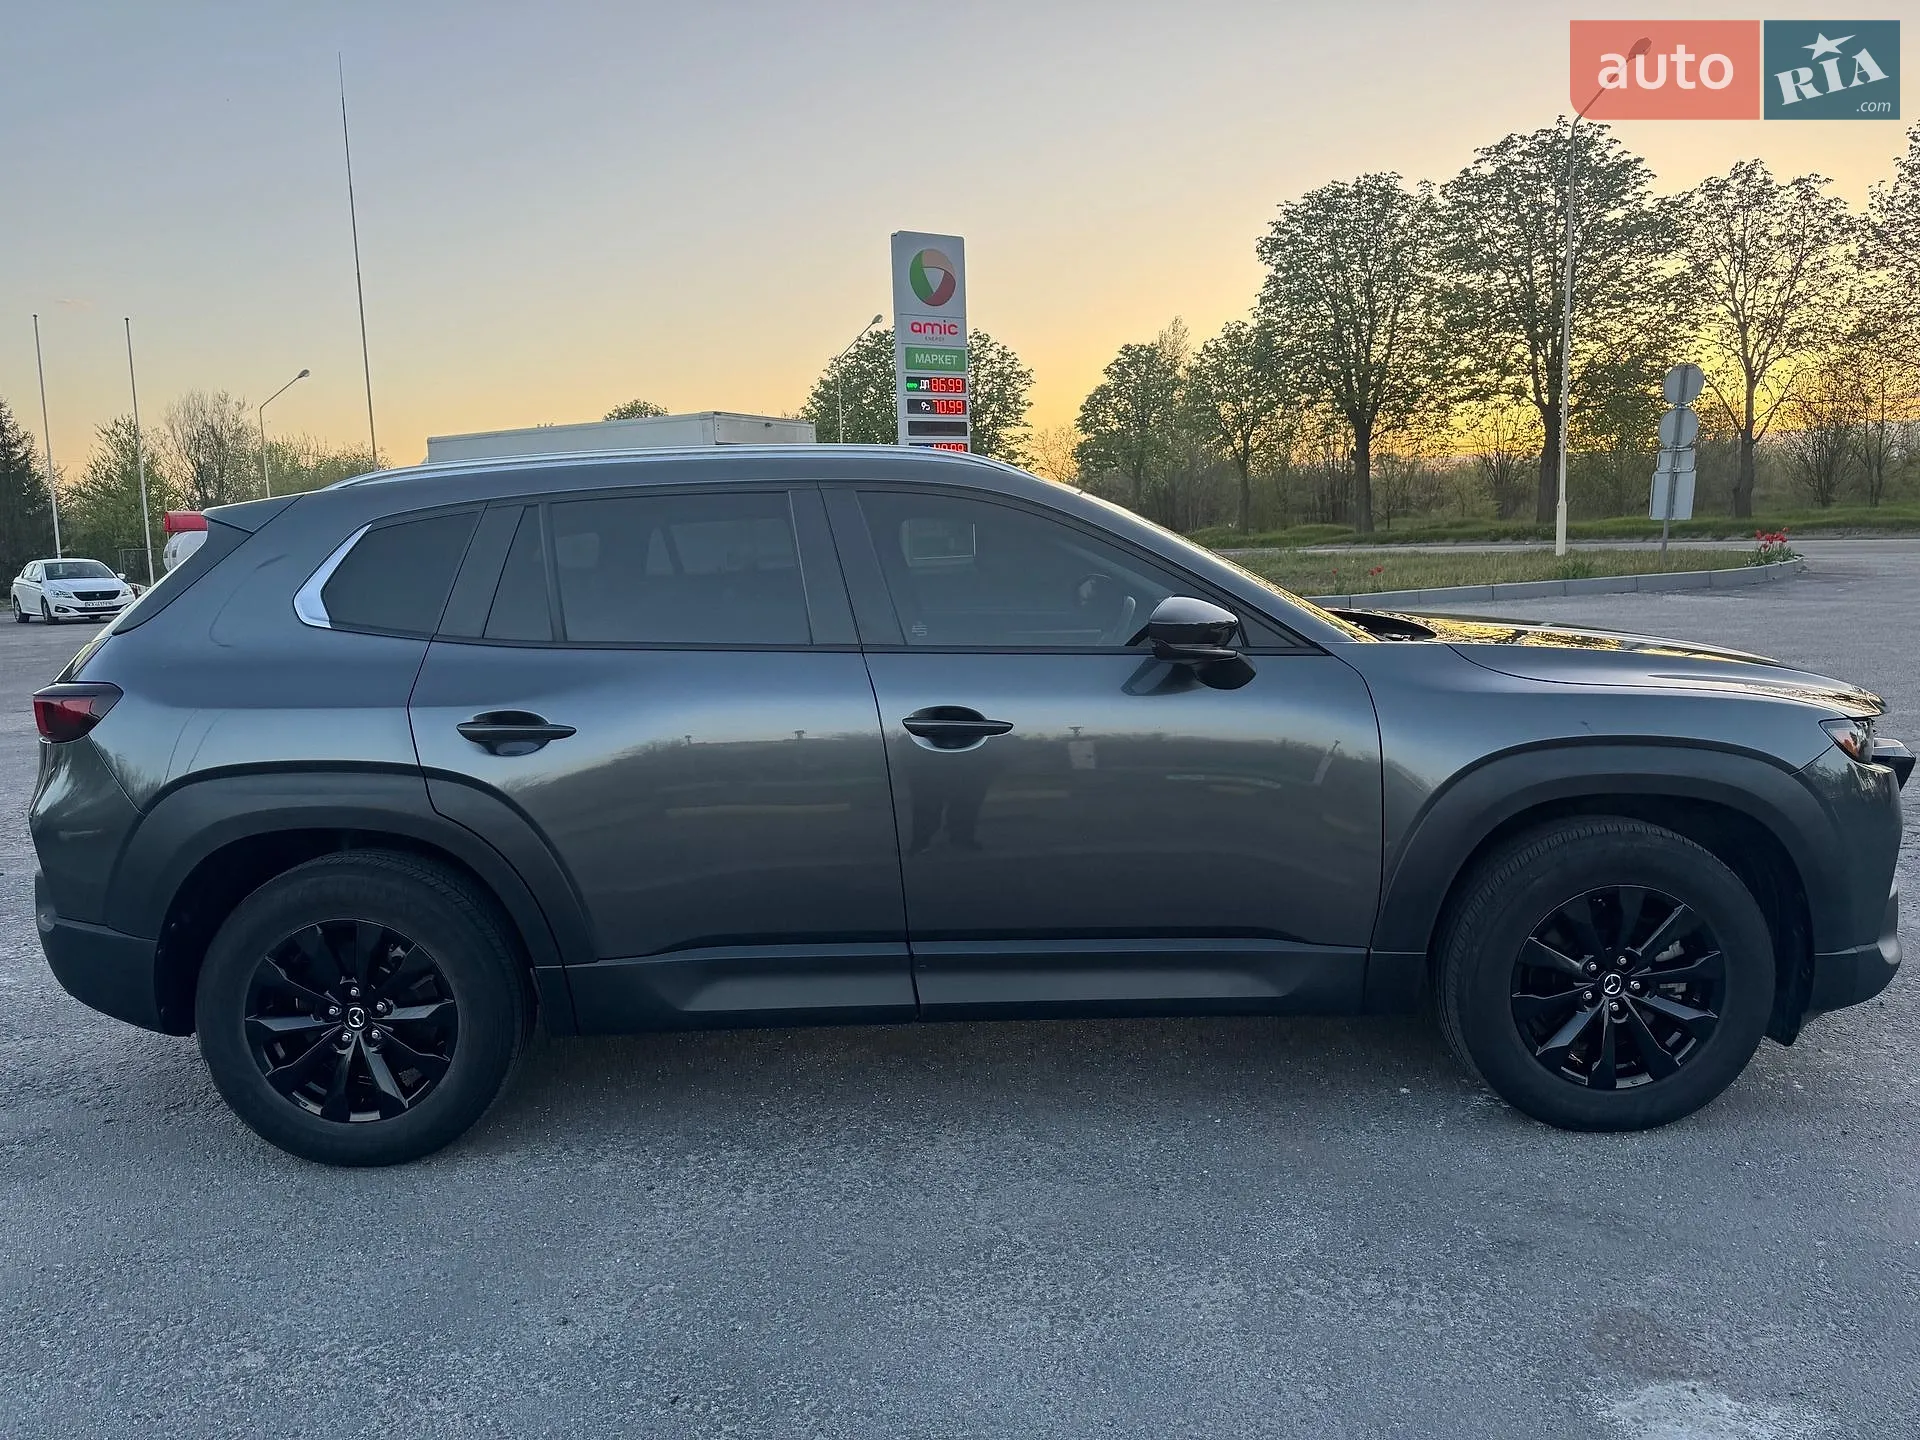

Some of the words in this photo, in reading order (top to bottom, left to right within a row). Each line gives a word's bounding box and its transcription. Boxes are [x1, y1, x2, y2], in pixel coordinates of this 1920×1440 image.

[910, 320, 958, 336] amic
[915, 353, 958, 365] МАРКЕТ
[919, 379, 930, 390] ДП
[932, 400, 963, 414] 70.99
